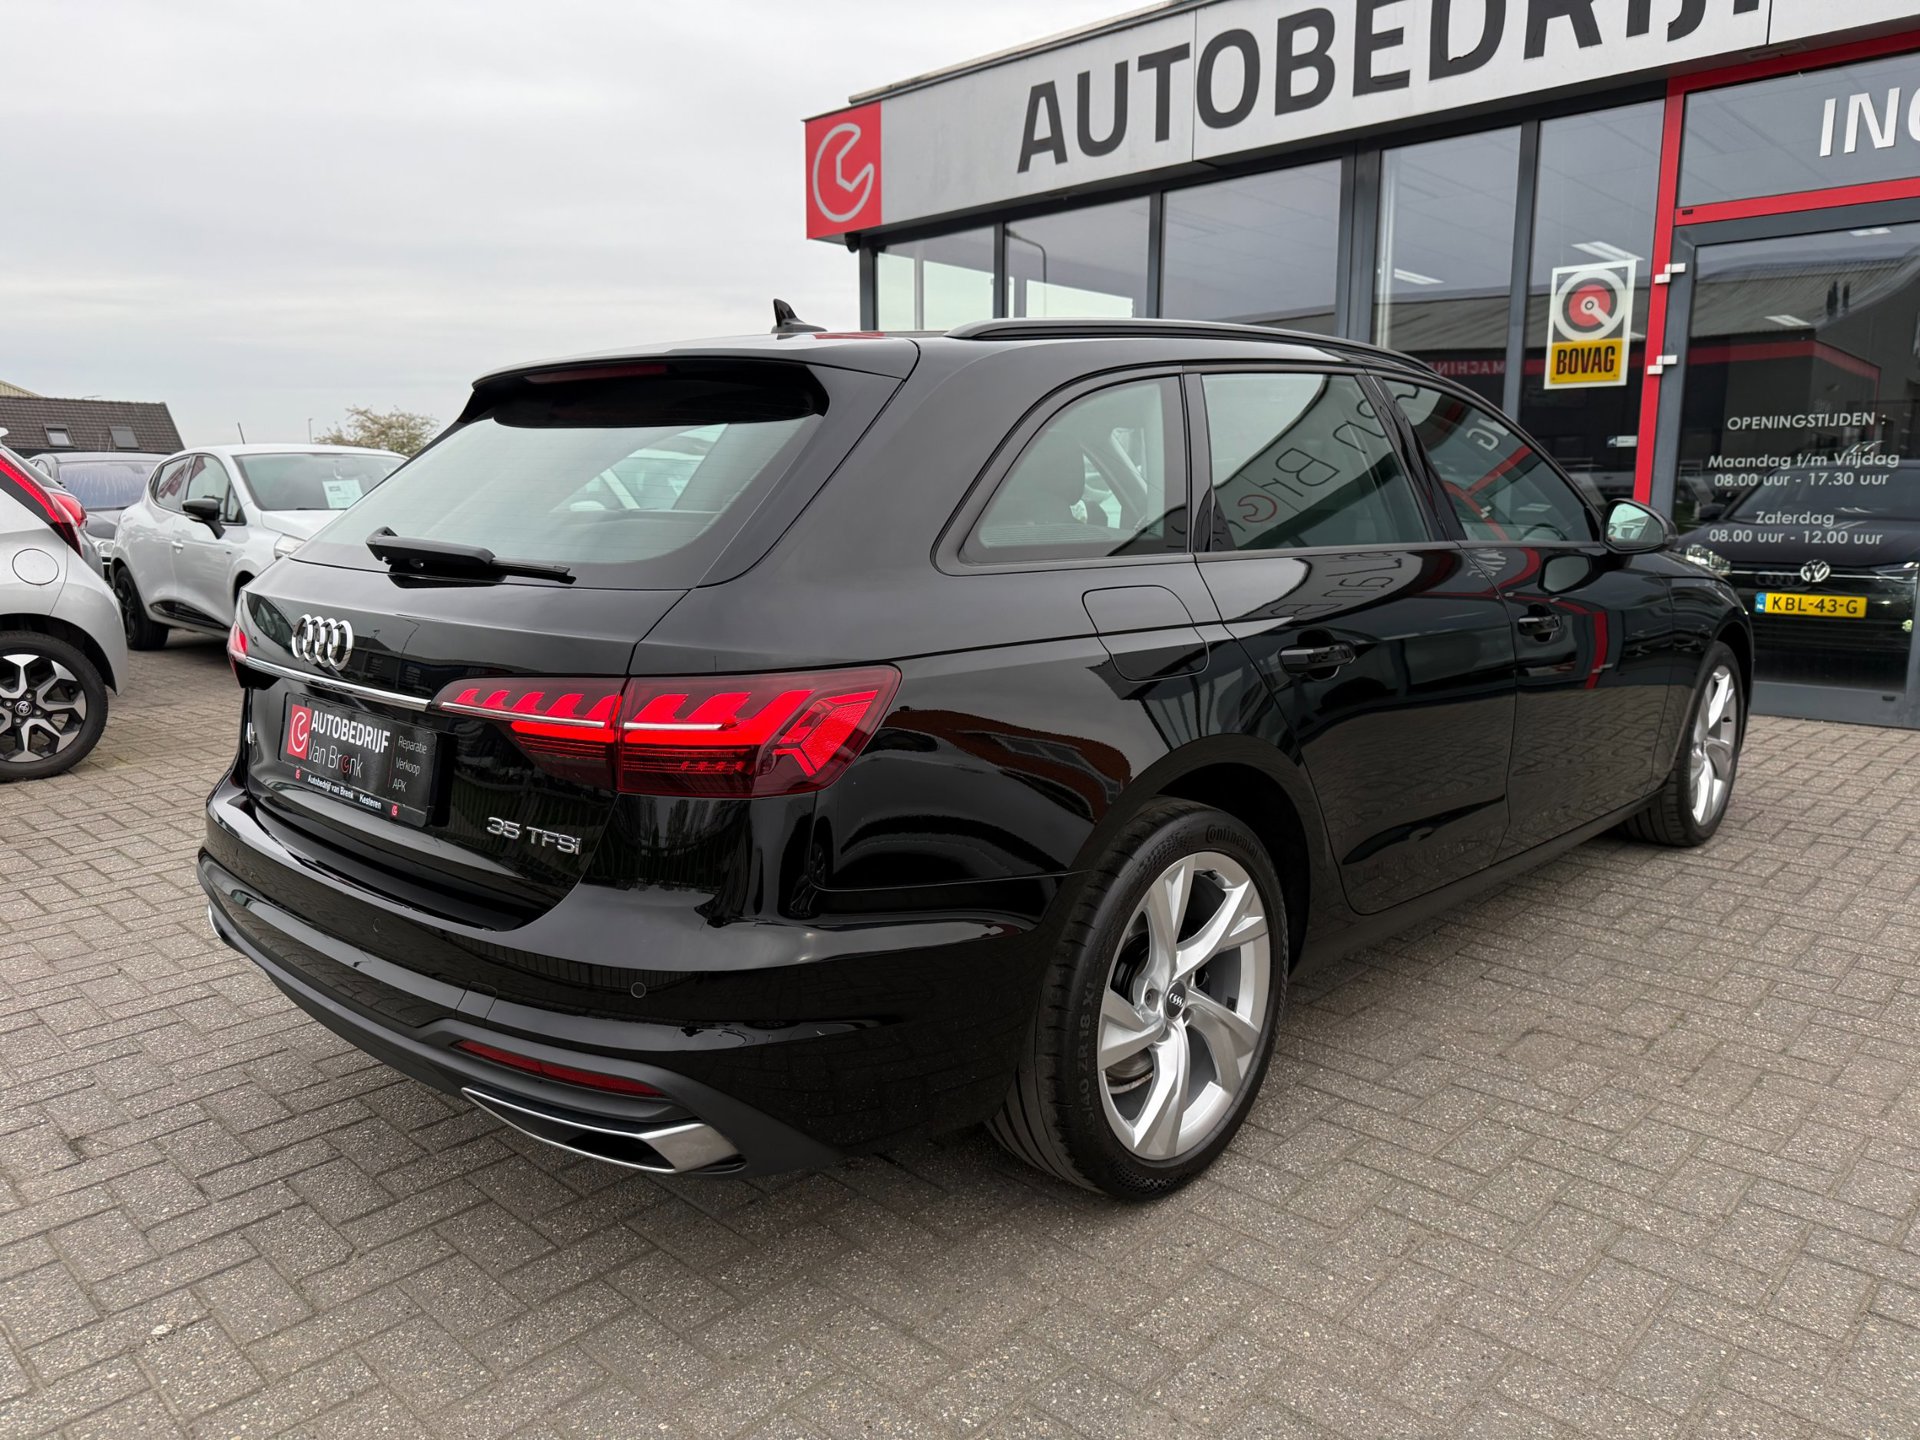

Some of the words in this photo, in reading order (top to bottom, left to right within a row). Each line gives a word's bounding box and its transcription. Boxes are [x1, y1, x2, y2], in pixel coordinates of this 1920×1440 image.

[1018, 0, 1757, 173] AUTOBED
[1819, 86, 1920, 157] IN
[1556, 345, 1616, 375] BOVAG
[1727, 412, 1876, 431] OPENINGSTIJDEN
[1708, 454, 1791, 470] Maandag
[1796, 453, 1827, 467] t/m
[1833, 451, 1900, 469] Vrijdag
[1714, 473, 1758, 487] 08.00
[1763, 475, 1790, 486] uur
[1808, 472, 1854, 486] 17.30
[1859, 473, 1890, 485] uur
[1755, 511, 1835, 527] Zaterdag
[1709, 529, 1752, 543] 08.00
[1757, 532, 1784, 543] uur
[1803, 530, 1848, 544] 12.00
[1853, 533, 1883, 545] uur
[1772, 596, 1858, 614] KBL-43-G
[311, 710, 391, 753] AUTOBEDRIJF
[308, 738, 327, 764] Van
[398, 736, 428, 755] Reparatie
[396, 757, 421, 776] Verkoop
[308, 775, 331, 793] Autobedrijf
[331, 784, 339, 796] van
[339, 786, 354, 799] Brenk
[359, 794, 382, 810] Kesteren
[392, 778, 407, 793] APK
[487, 817, 521, 841] 35
